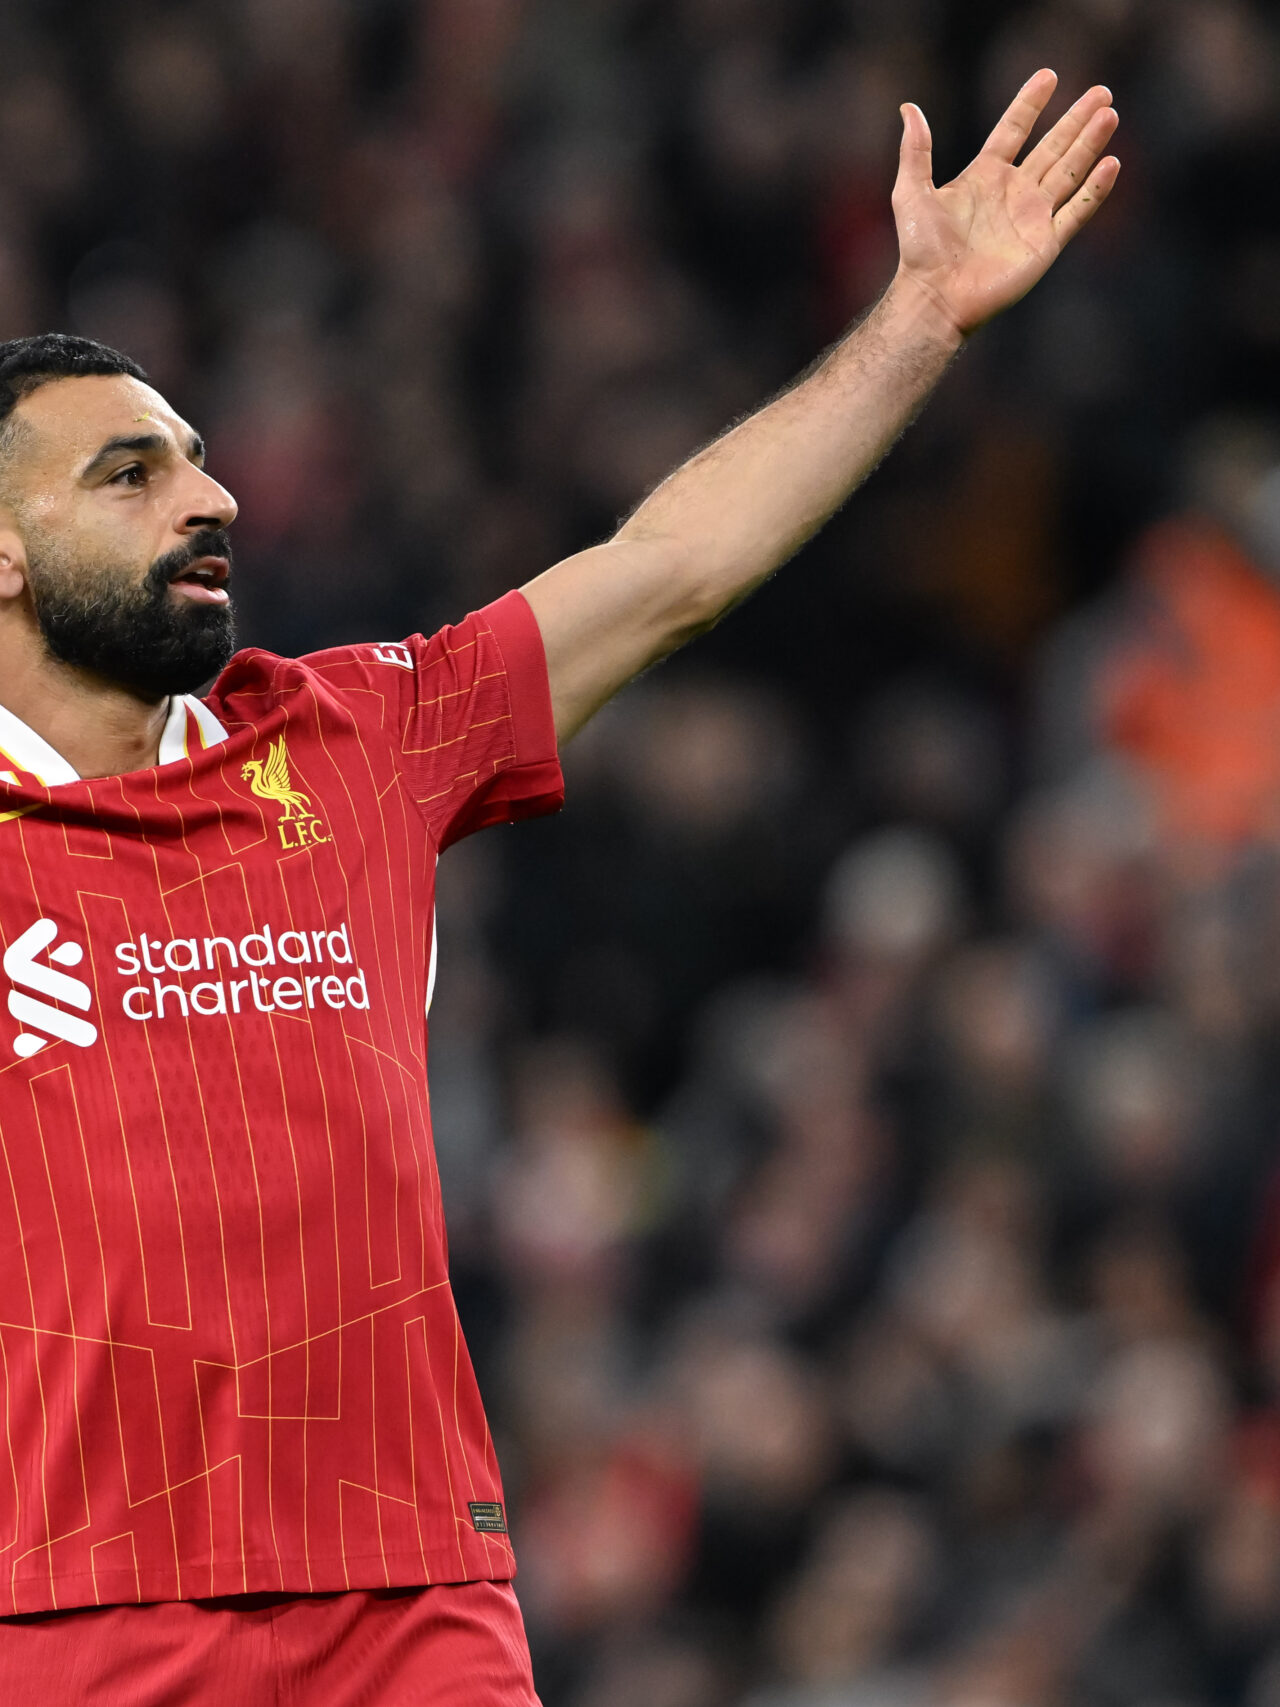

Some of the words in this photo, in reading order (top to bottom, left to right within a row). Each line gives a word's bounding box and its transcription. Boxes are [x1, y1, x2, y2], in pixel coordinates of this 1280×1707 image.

[278, 818, 333, 851] L.F.C.
[115, 922, 355, 977] standard
[122, 967, 371, 1021] chartered
